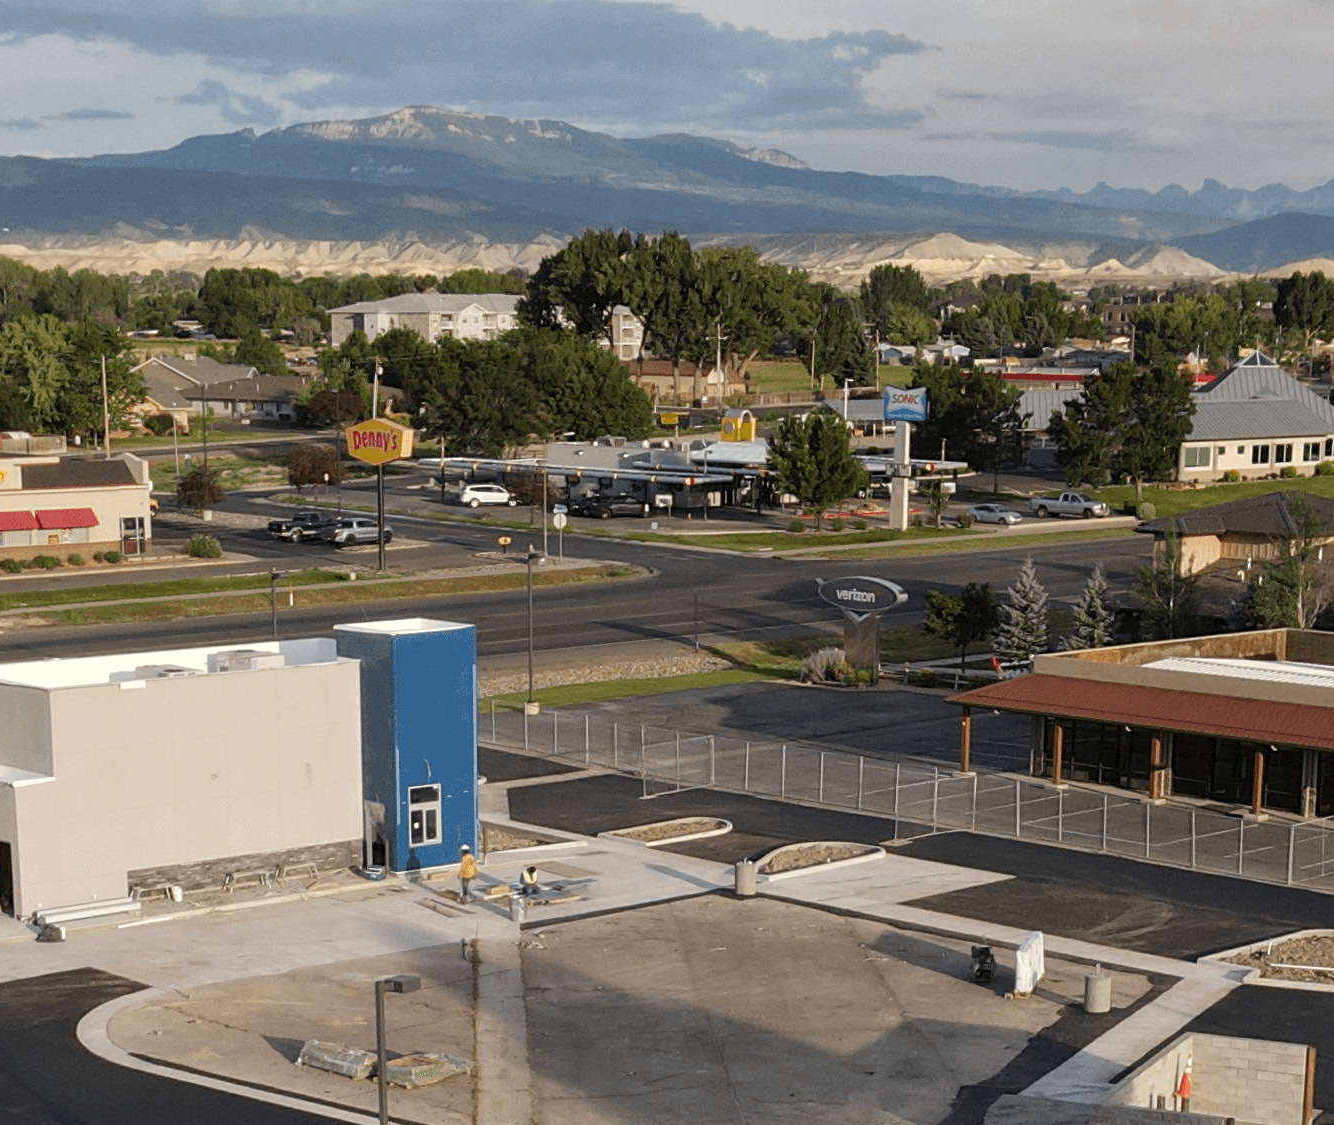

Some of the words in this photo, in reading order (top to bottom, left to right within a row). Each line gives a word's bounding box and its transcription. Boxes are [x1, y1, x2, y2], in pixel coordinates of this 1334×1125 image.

[892, 393, 919, 405] SONIC
[352, 430, 398, 453] Denny's
[835, 587, 876, 603] verizon
